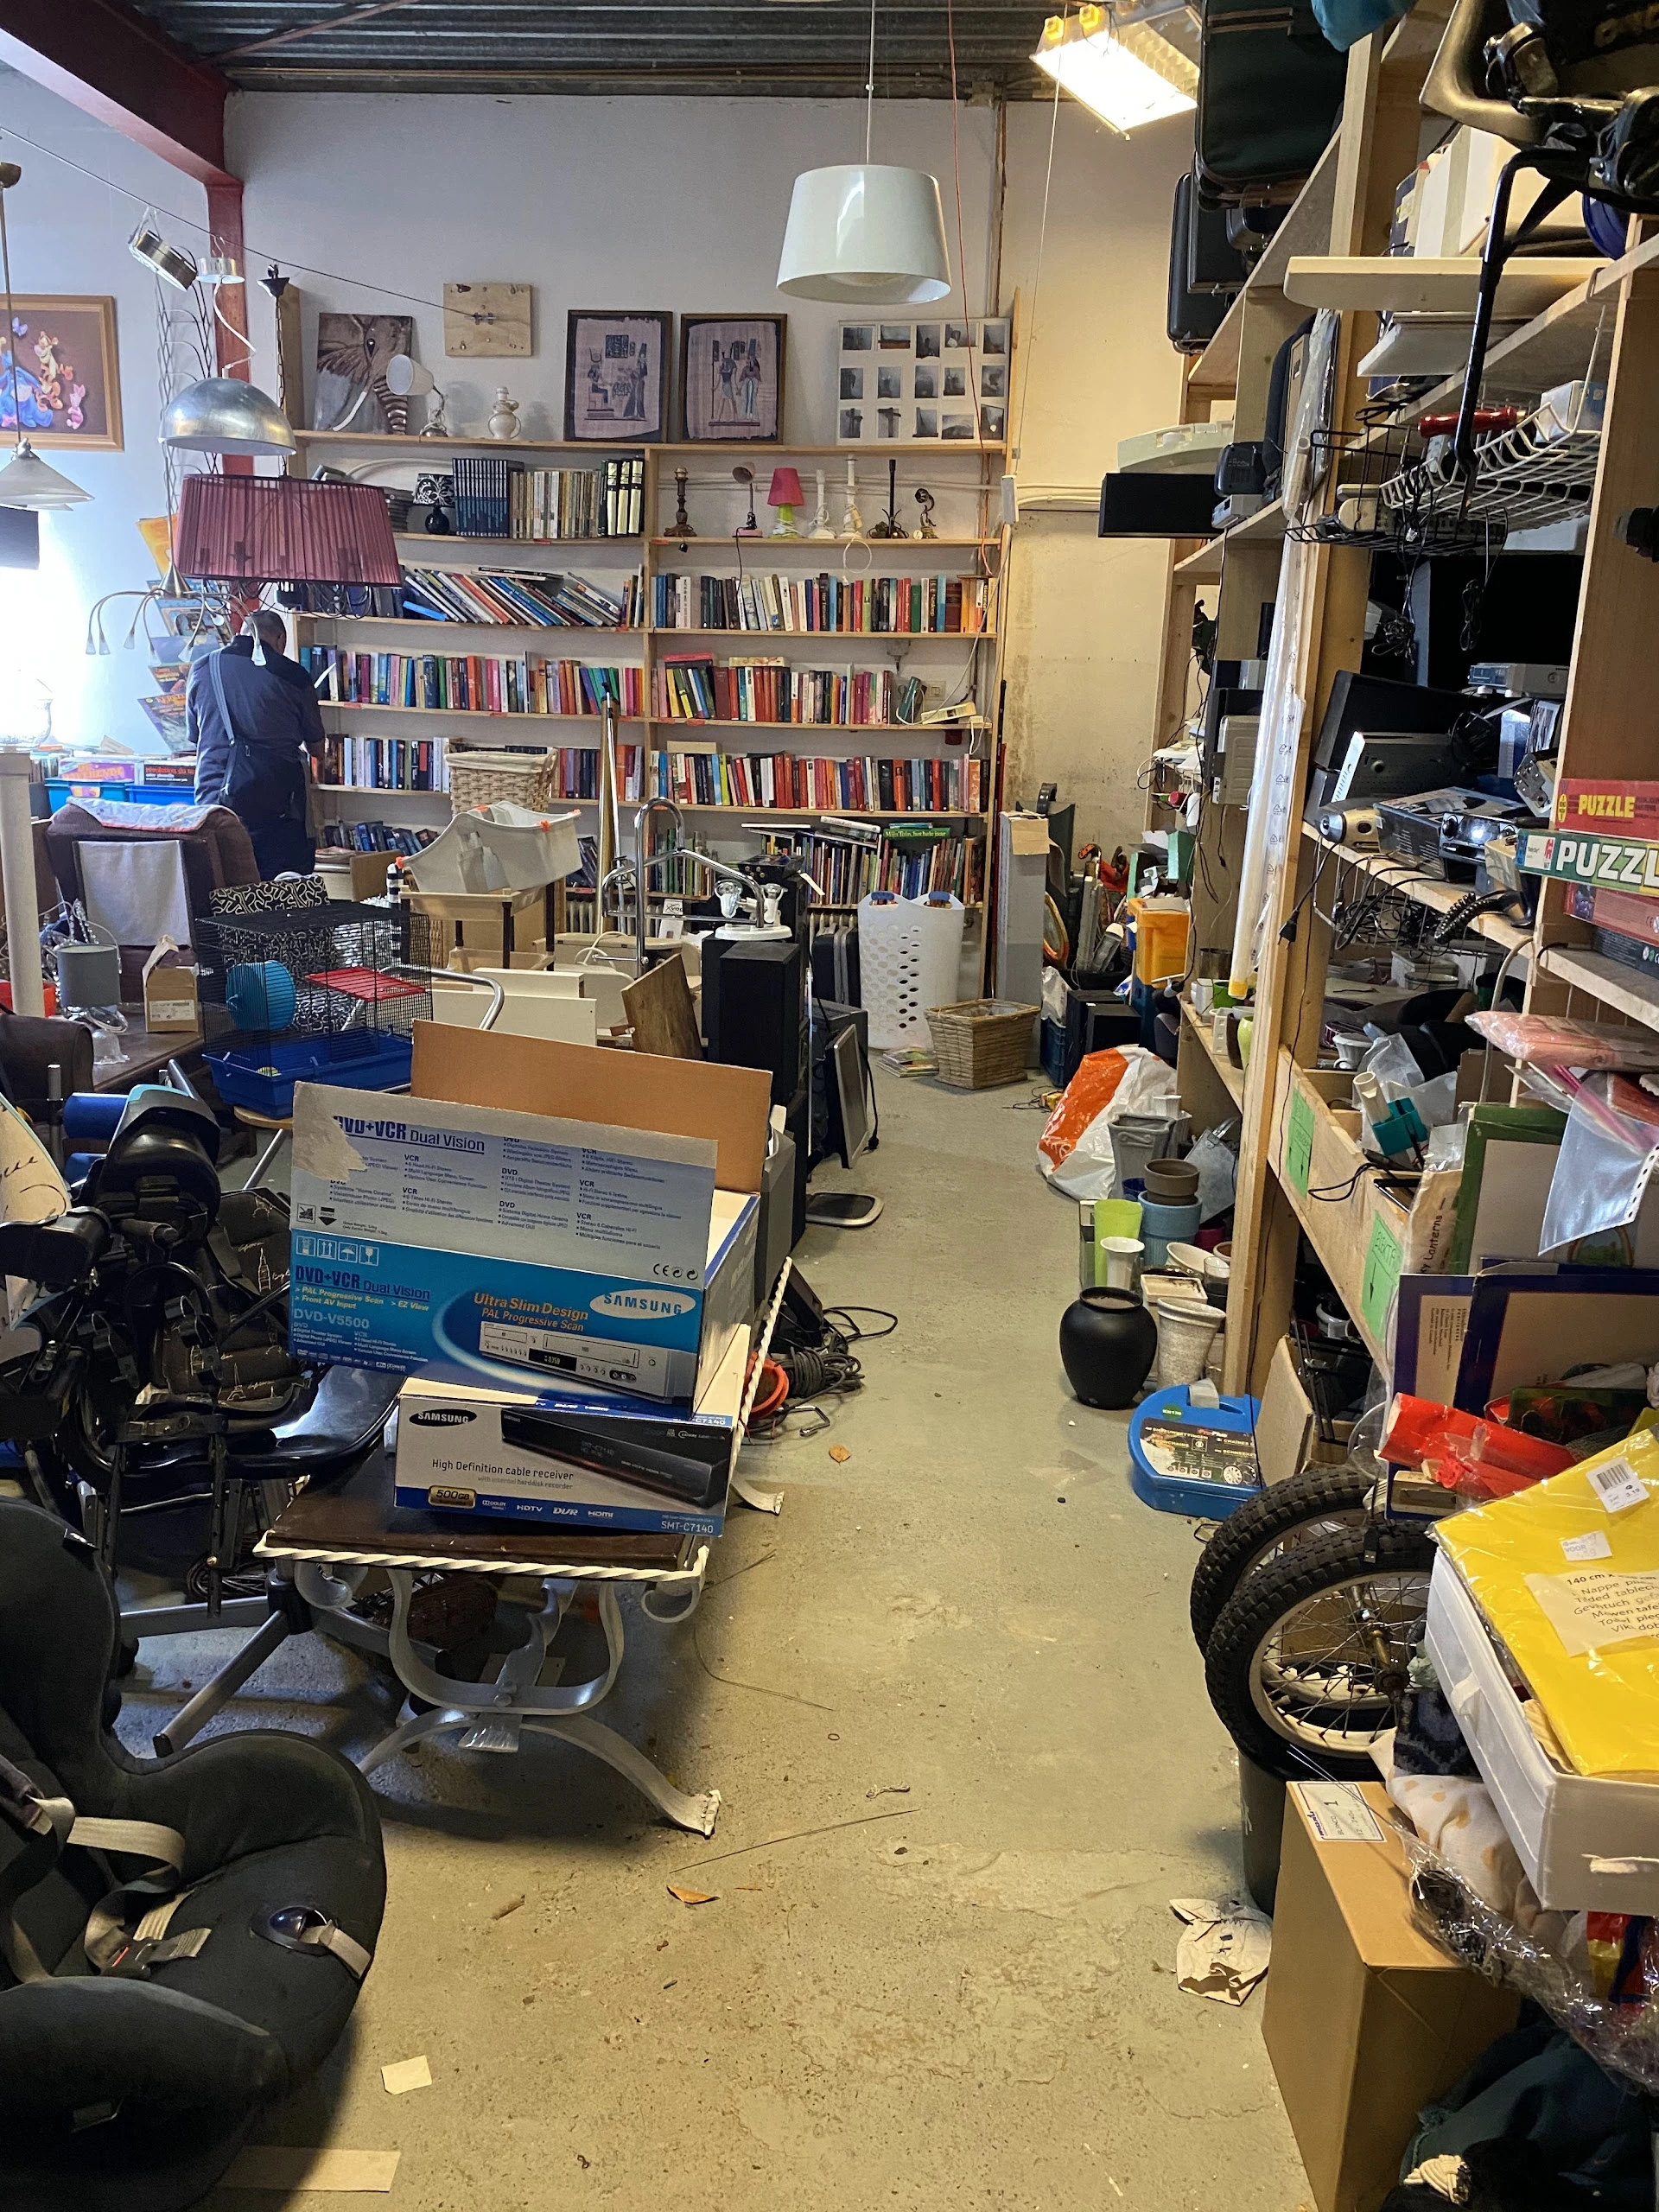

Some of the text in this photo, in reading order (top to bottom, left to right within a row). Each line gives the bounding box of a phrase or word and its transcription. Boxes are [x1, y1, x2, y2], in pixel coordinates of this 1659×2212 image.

[1578, 795, 1636, 818] PUZZLE
[410, 1129, 440, 1145] Dual
[444, 1134, 486, 1152] Vision
[1423, 1215, 1442, 1260] Lanterns
[296, 1265, 360, 1290] DVD+VCR
[364, 1281, 390, 1294] Dual
[393, 1285, 430, 1300] Vision
[302, 1295, 321, 1304] Front
[337, 1300, 356, 1309] Input
[320, 1289, 363, 1301] Progressive
[365, 1296, 384, 1305] Scan
[604, 1294, 682, 1314] SAMSUNG
[474, 1293, 588, 1321] Ultra Slim Design
[294, 1308, 370, 1329] DVD-V5500
[482, 1308, 584, 1332] PAL Progressive Scan
[418, 1412, 469, 1423] SAMSUNG
[432, 1459, 574, 1480] High Definition cable receiver
[436, 1490, 469, 1500] 500GB
[553, 1507, 578, 1516] DVR
[661, 1521, 714, 1534] SMT-C7140
[1564, 1544, 1586, 1553] VOOR
[1567, 1576, 1586, 1585] 140
[1581, 1582, 1619, 1595] Nappe
